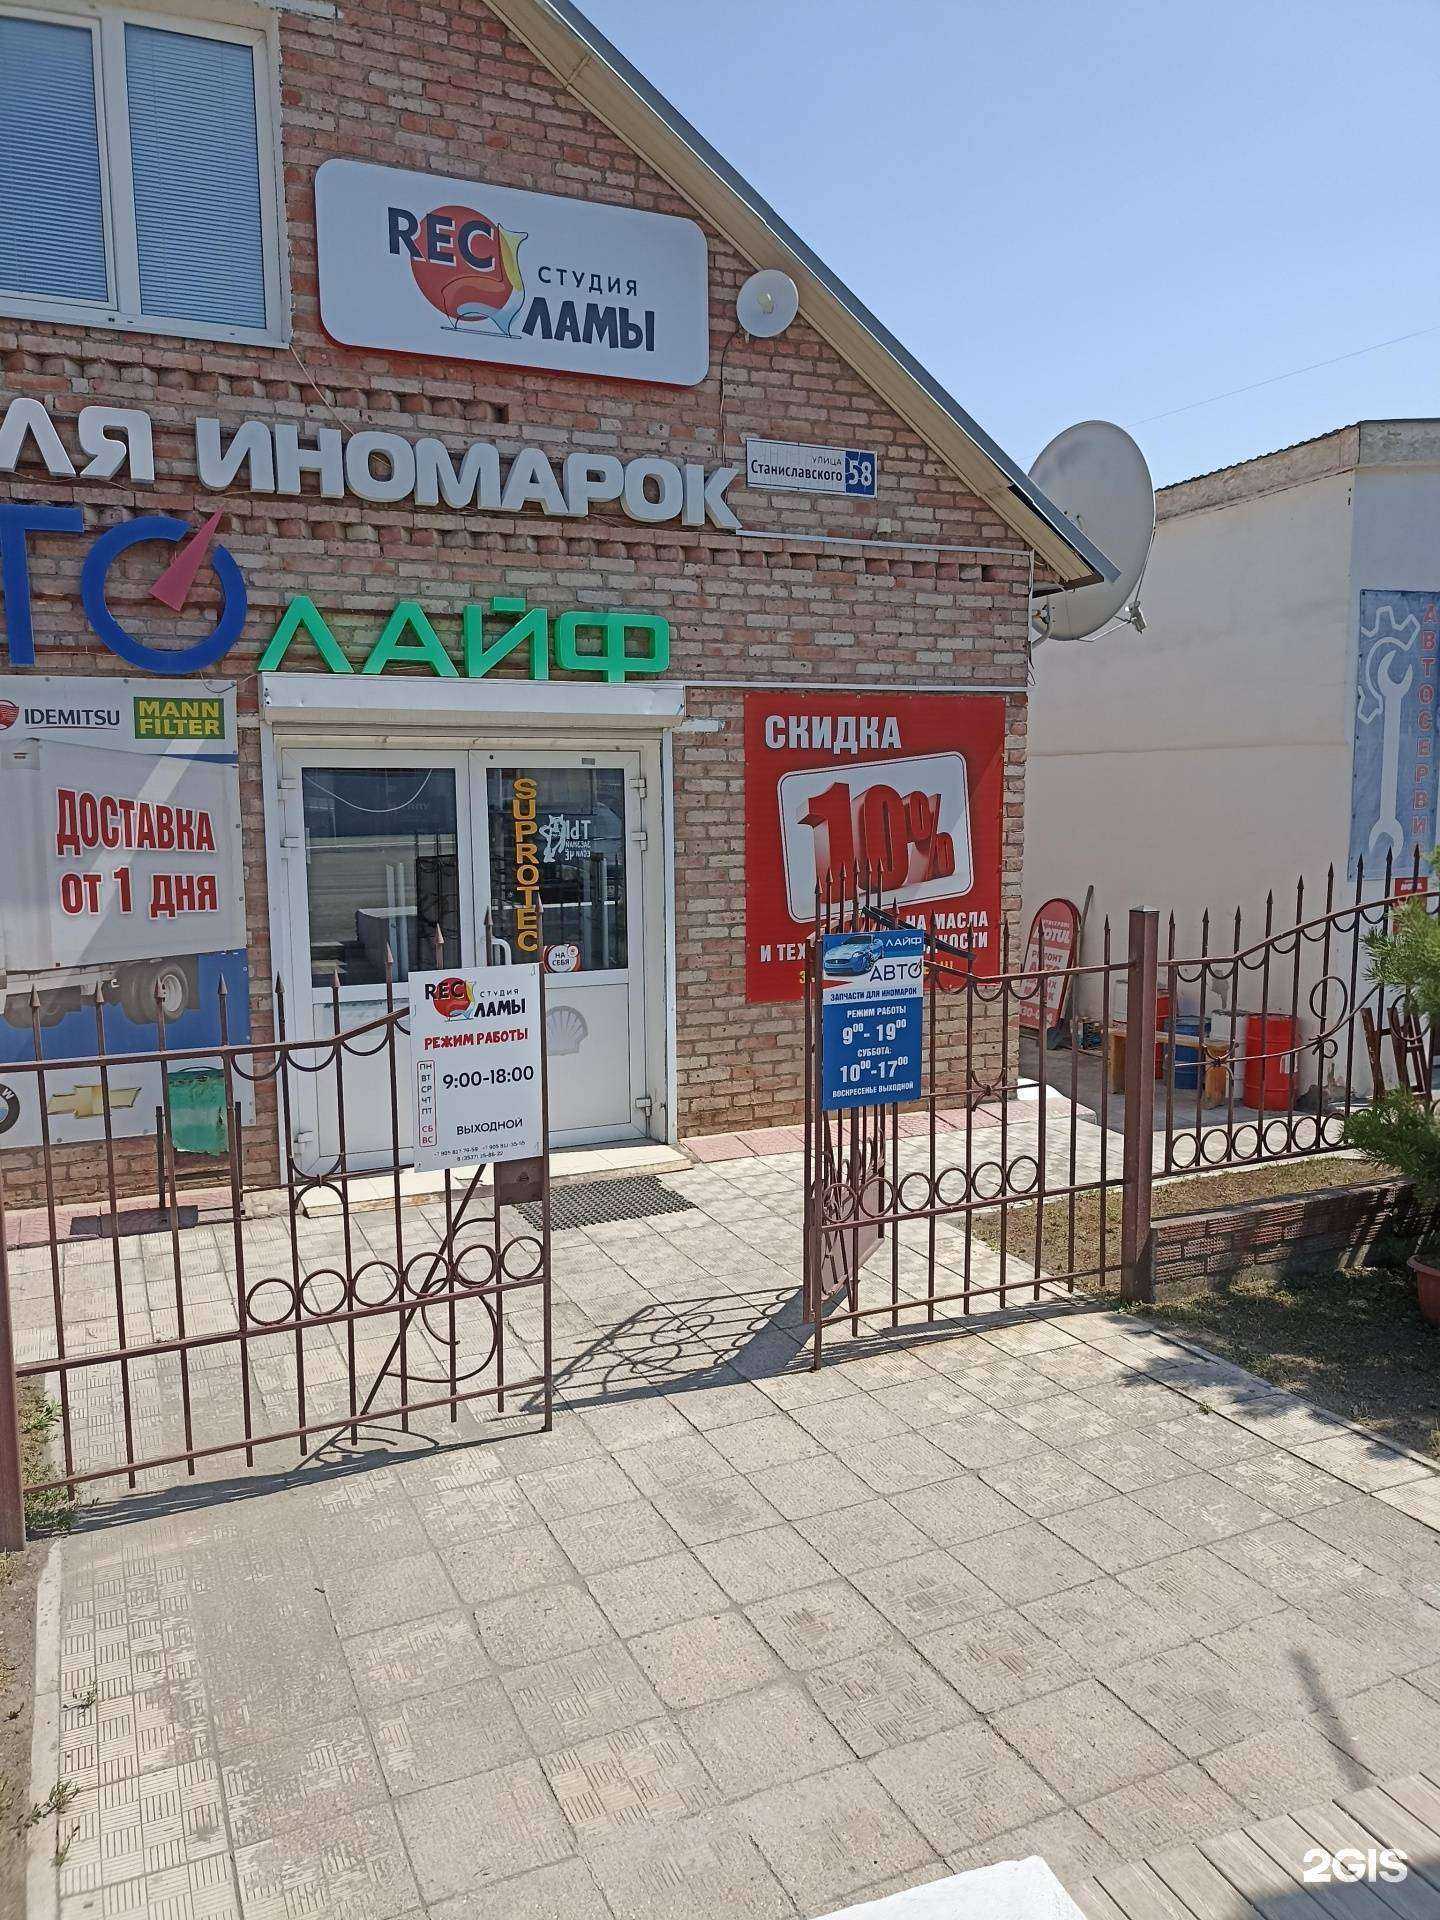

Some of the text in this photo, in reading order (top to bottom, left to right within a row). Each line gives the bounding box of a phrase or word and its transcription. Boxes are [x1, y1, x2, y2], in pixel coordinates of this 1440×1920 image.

[538, 266, 638, 297] СТУДИЯ
[521, 296, 656, 352] ЛАМЫ
[0, 397, 743, 531] ЛЯ ИНОМАРОК
[750, 459, 872, 487] Станиславского 58
[0, 504, 248, 676] ТО
[257, 595, 672, 684] ЛАЙФ
[24, 708, 120, 726] IDEMITSU
[138, 700, 219, 718] MANN
[139, 718, 220, 736] FILTER
[764, 714, 902, 755] СКИДКА
[56, 788, 216, 857] ДОСТАВКА
[796, 781, 957, 905] 10%
[512, 778, 540, 952] SUPROTEC
[60, 866, 218, 920] ОТ 1 ДНЯ
[904, 910, 989, 932] НА МАСЛА
[885, 935, 922, 947] ЛАЙФ
[760, 945, 771, 962] И
[1032, 950, 1063, 963] РОНТ
[869, 959, 922, 982] АВТО
[480, 988, 519, 998] СТУДИЯ
[830, 987, 917, 1001] ЗАПЧАСТИ ДЛЯ ИНОМАРОК
[474, 998, 526, 1018] ЛАМЫ
[846, 1005, 907, 1018] РЕЖИМ РАБОТЫ
[424, 1027, 529, 1050] РЕЖИМ РАБОТЫ
[419, 1063, 432, 1071] ПН
[421, 1074, 431, 1082] ВТ
[442, 1065, 534, 1089] 9:00-18:00
[421, 1085, 432, 1093] СР
[832, 1080, 914, 1098] ВОСКРЕСЕНЬЕ ВЫХОДНОЙ
[421, 1096, 431, 1104] ЧТ
[421, 1107, 432, 1115] ПТ
[421, 1125, 434, 1133] СБ
[456, 1118, 523, 1135] ВЫХОДНОЙ
[422, 1136, 433, 1144] ВС
